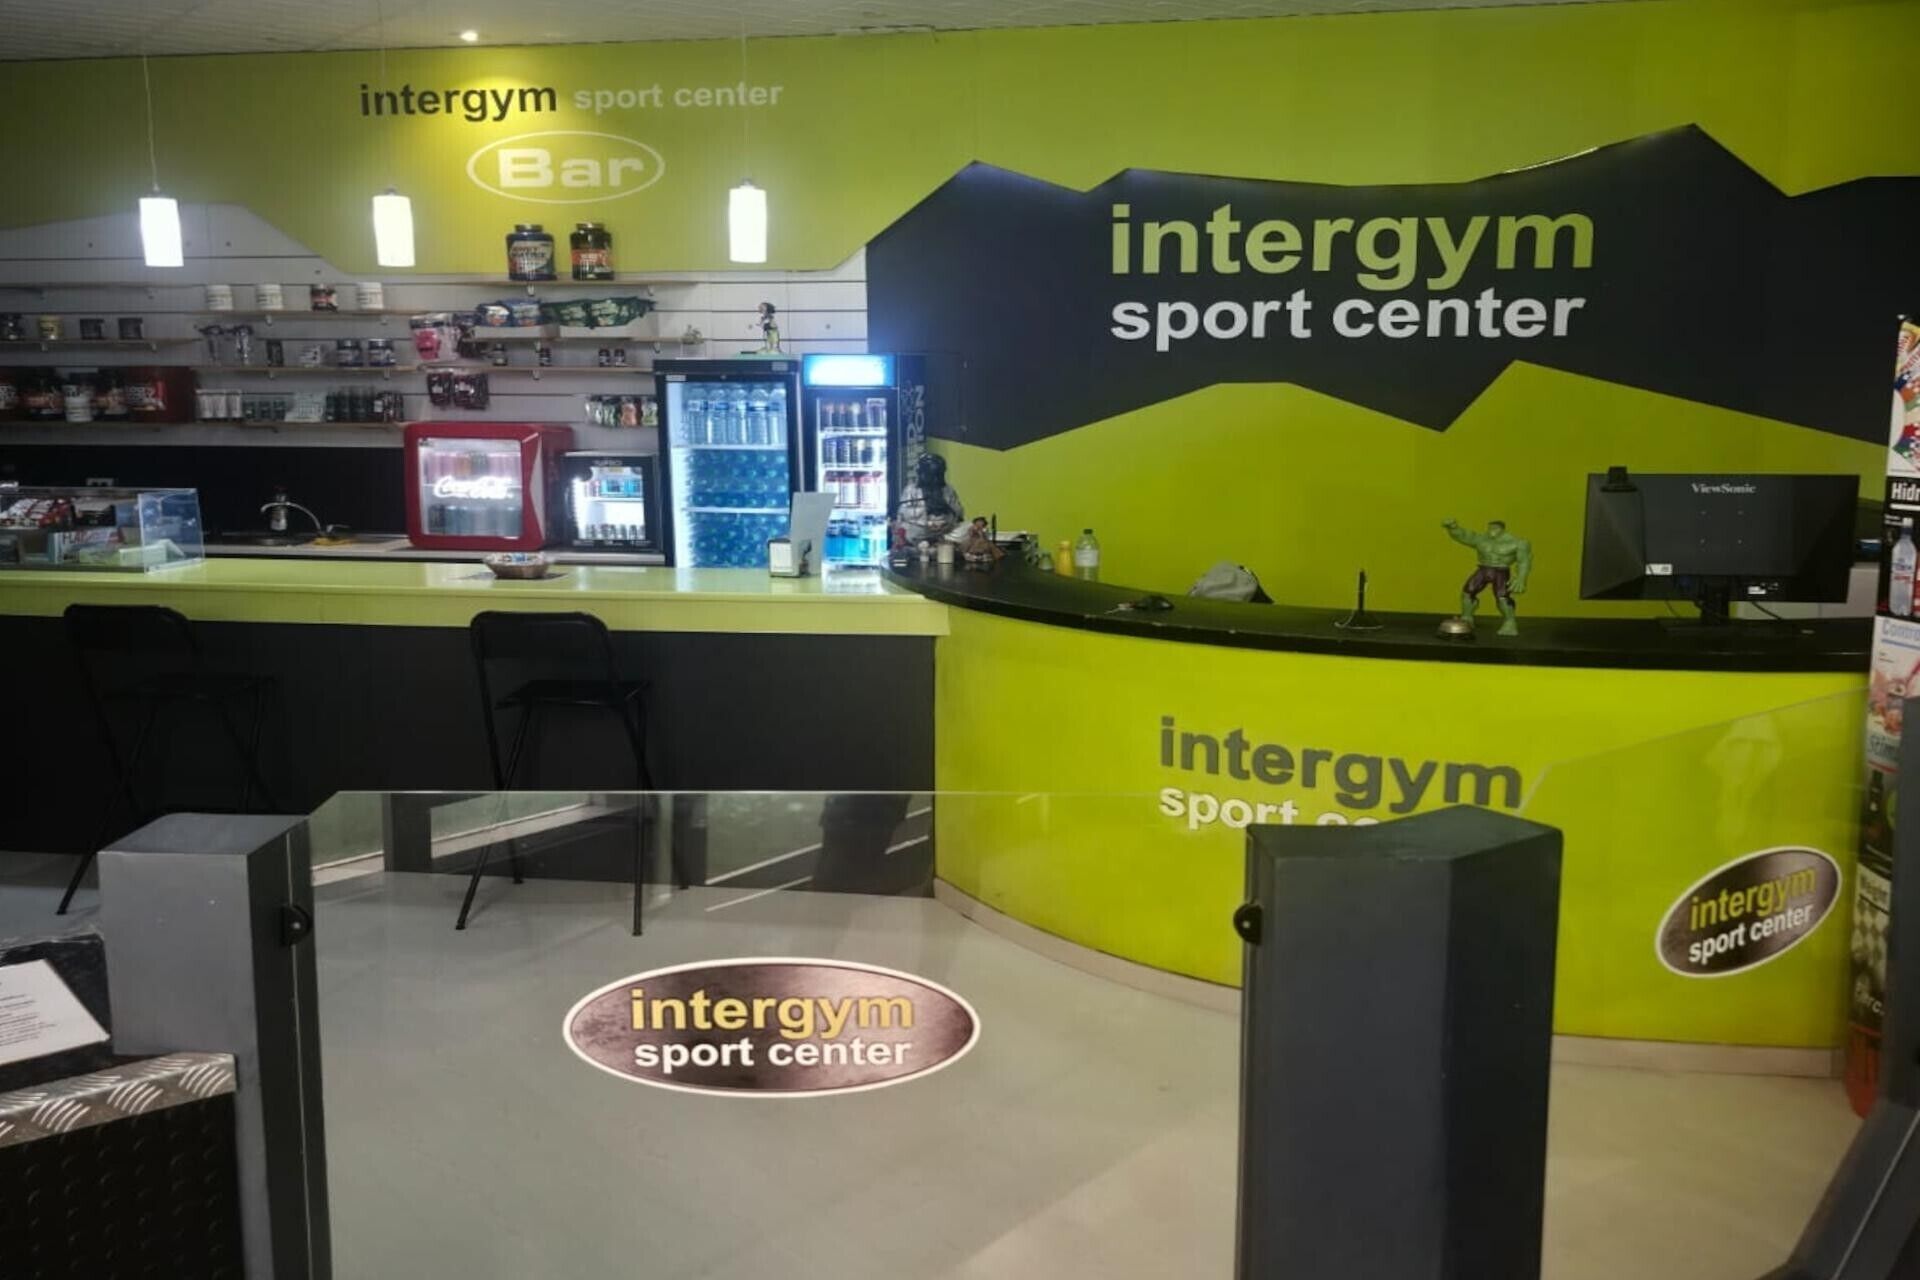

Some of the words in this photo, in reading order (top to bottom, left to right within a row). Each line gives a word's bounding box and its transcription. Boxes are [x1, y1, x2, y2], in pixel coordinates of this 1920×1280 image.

[361, 84, 557, 121] intergym
[574, 84, 663, 114] sport
[674, 82, 784, 107] center
[496, 148, 644, 188] Bar
[1111, 203, 1594, 291] intergym
[1110, 288, 1311, 351] sport
[1332, 287, 1586, 338] center
[1691, 483, 1756, 494] ViewSonic
[1160, 715, 1522, 813] intergym
[1690, 867, 1817, 930] intergym
[1688, 923, 1746, 965] sport
[1750, 904, 1813, 941] center
[631, 989, 914, 1040] intergym
[635, 1038, 754, 1074] sport
[768, 1037, 912, 1066] center
